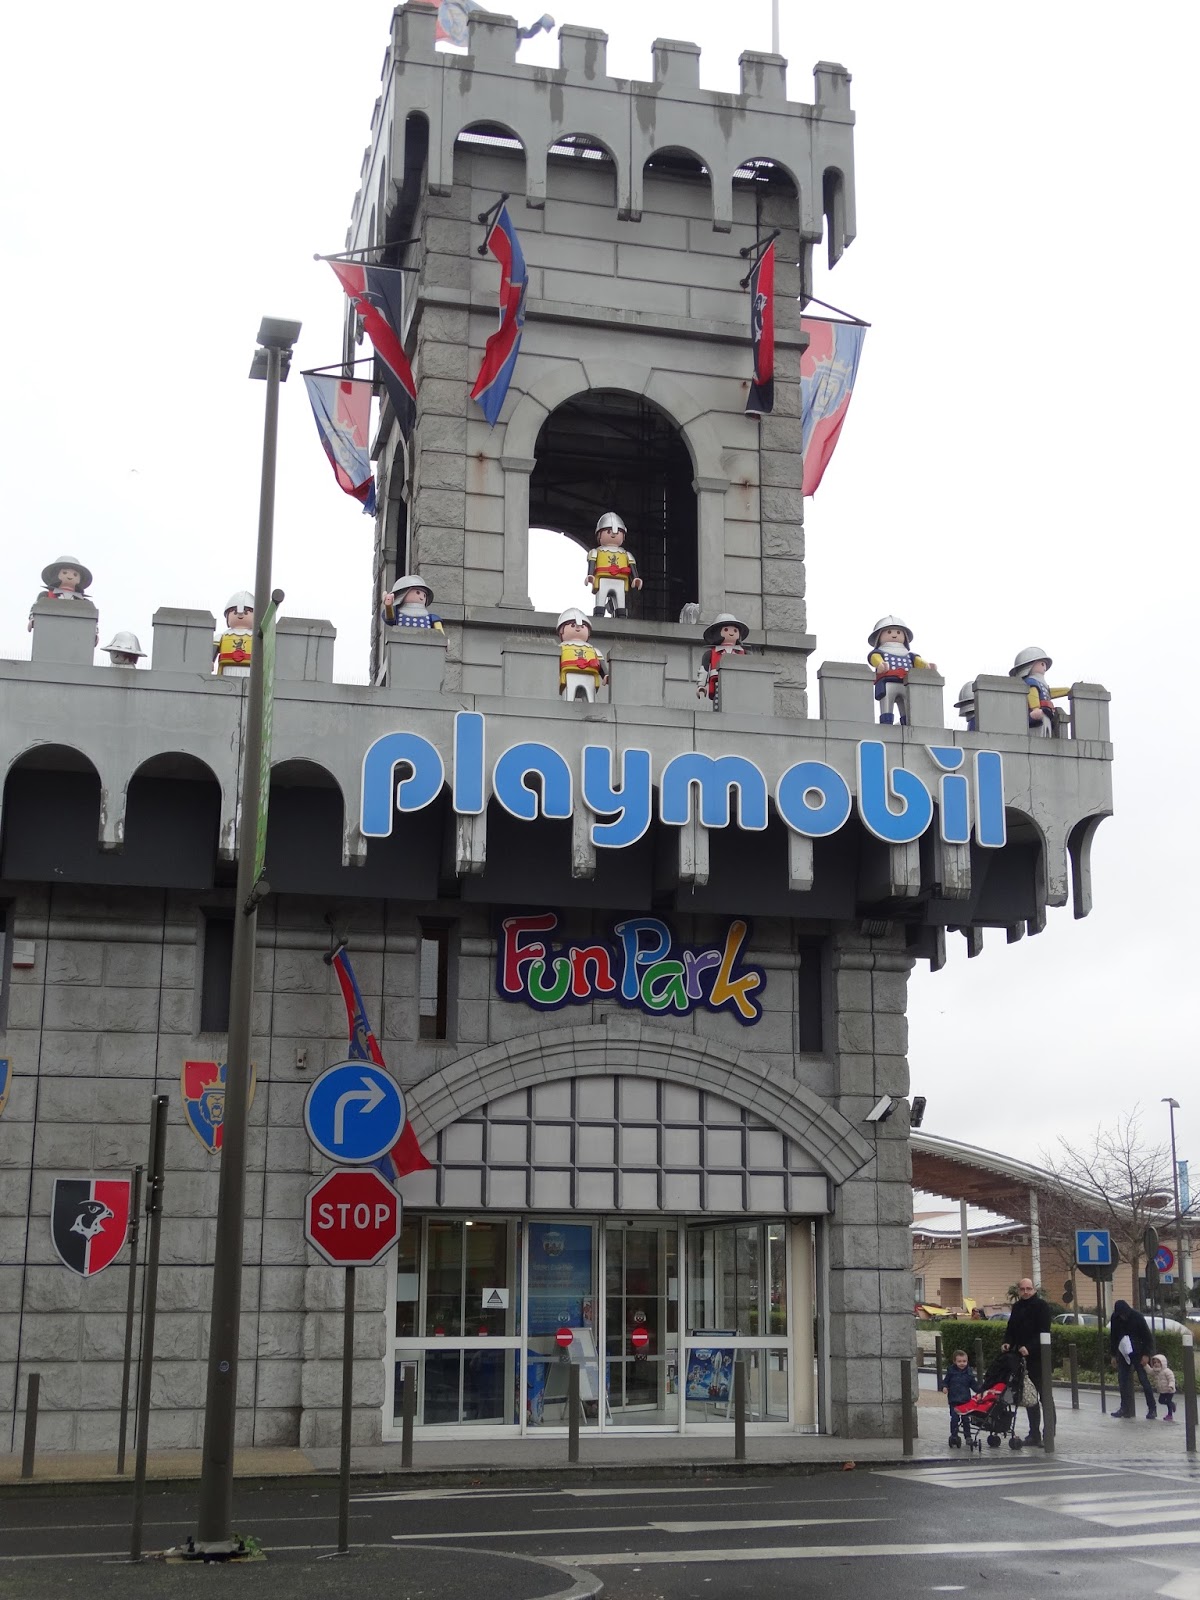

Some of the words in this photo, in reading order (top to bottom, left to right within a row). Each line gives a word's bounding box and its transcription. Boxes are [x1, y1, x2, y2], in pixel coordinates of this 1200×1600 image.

[360, 711, 1006, 848] playmobil
[502, 912, 616, 1004] Fun
[614, 917, 761, 1018] Park
[317, 1203, 391, 1230] STOP
